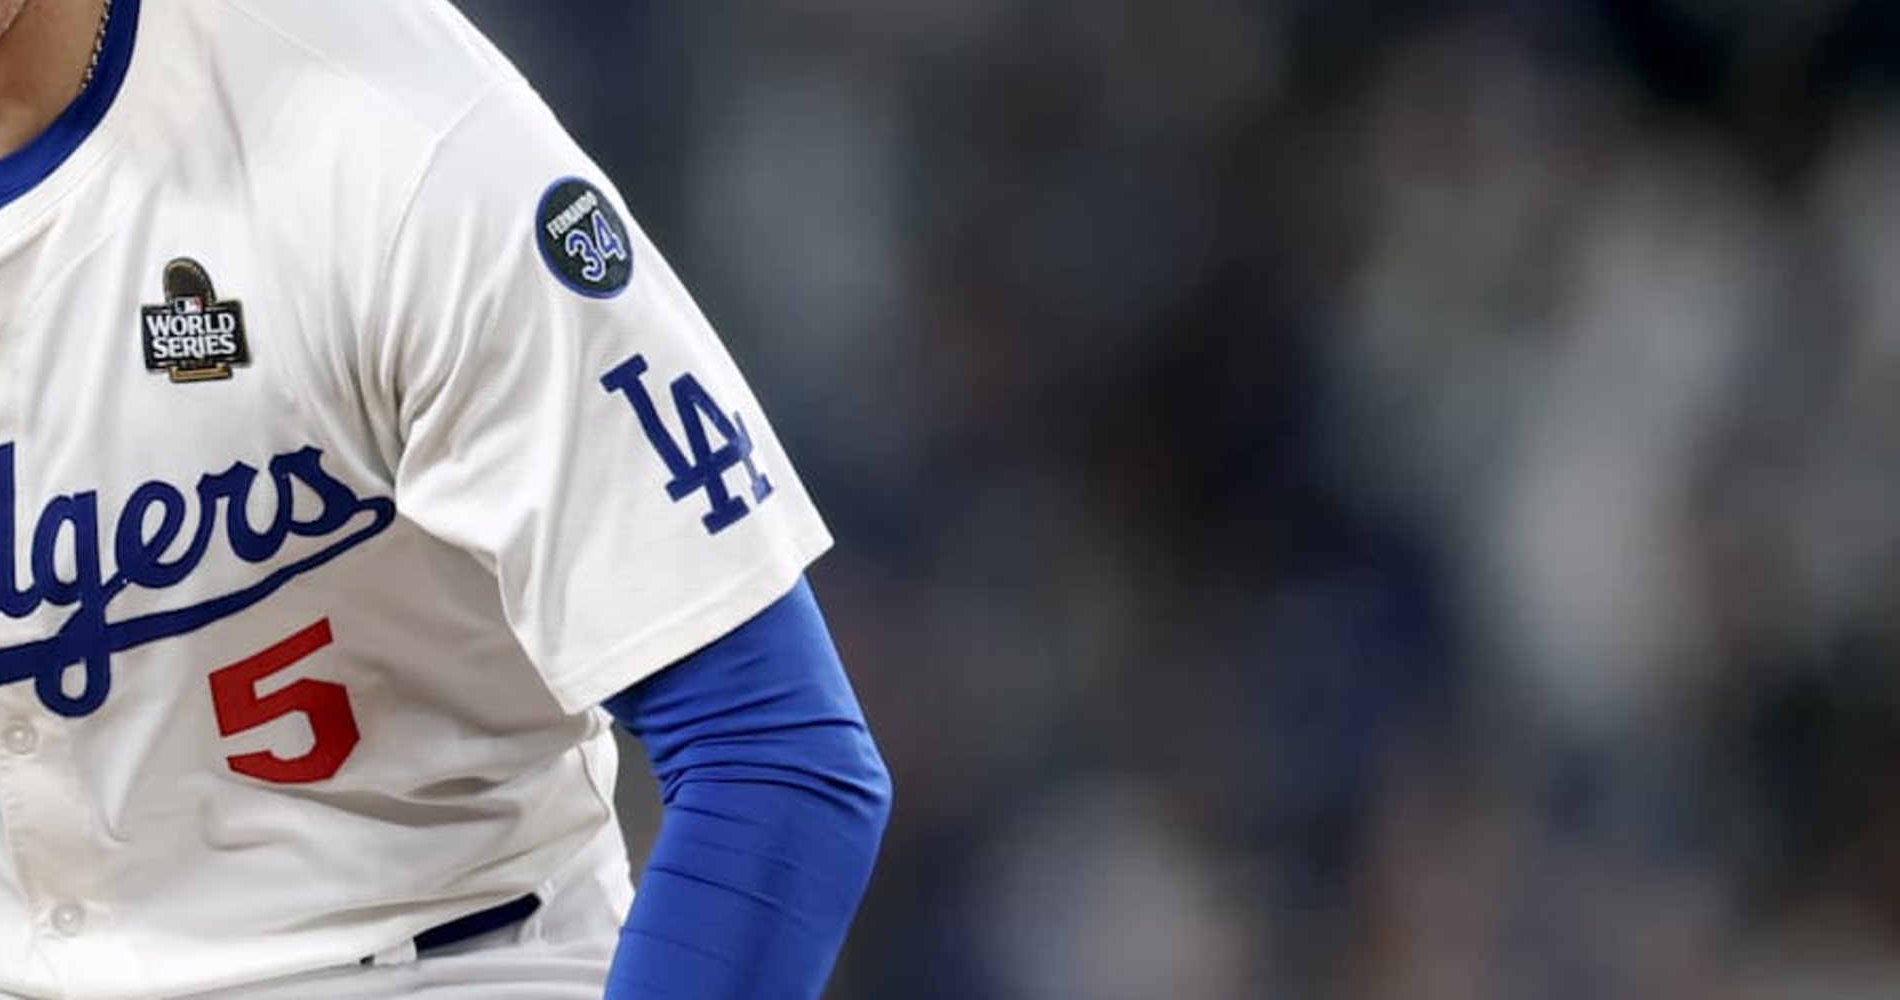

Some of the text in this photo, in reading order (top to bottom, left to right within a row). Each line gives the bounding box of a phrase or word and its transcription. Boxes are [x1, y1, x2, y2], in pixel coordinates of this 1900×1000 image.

[565, 210, 627, 282] 34
[146, 313, 236, 338] WORLD
[152, 333, 237, 359] SERIES
[599, 353, 774, 536] LA
[208, 616, 361, 783] 5
